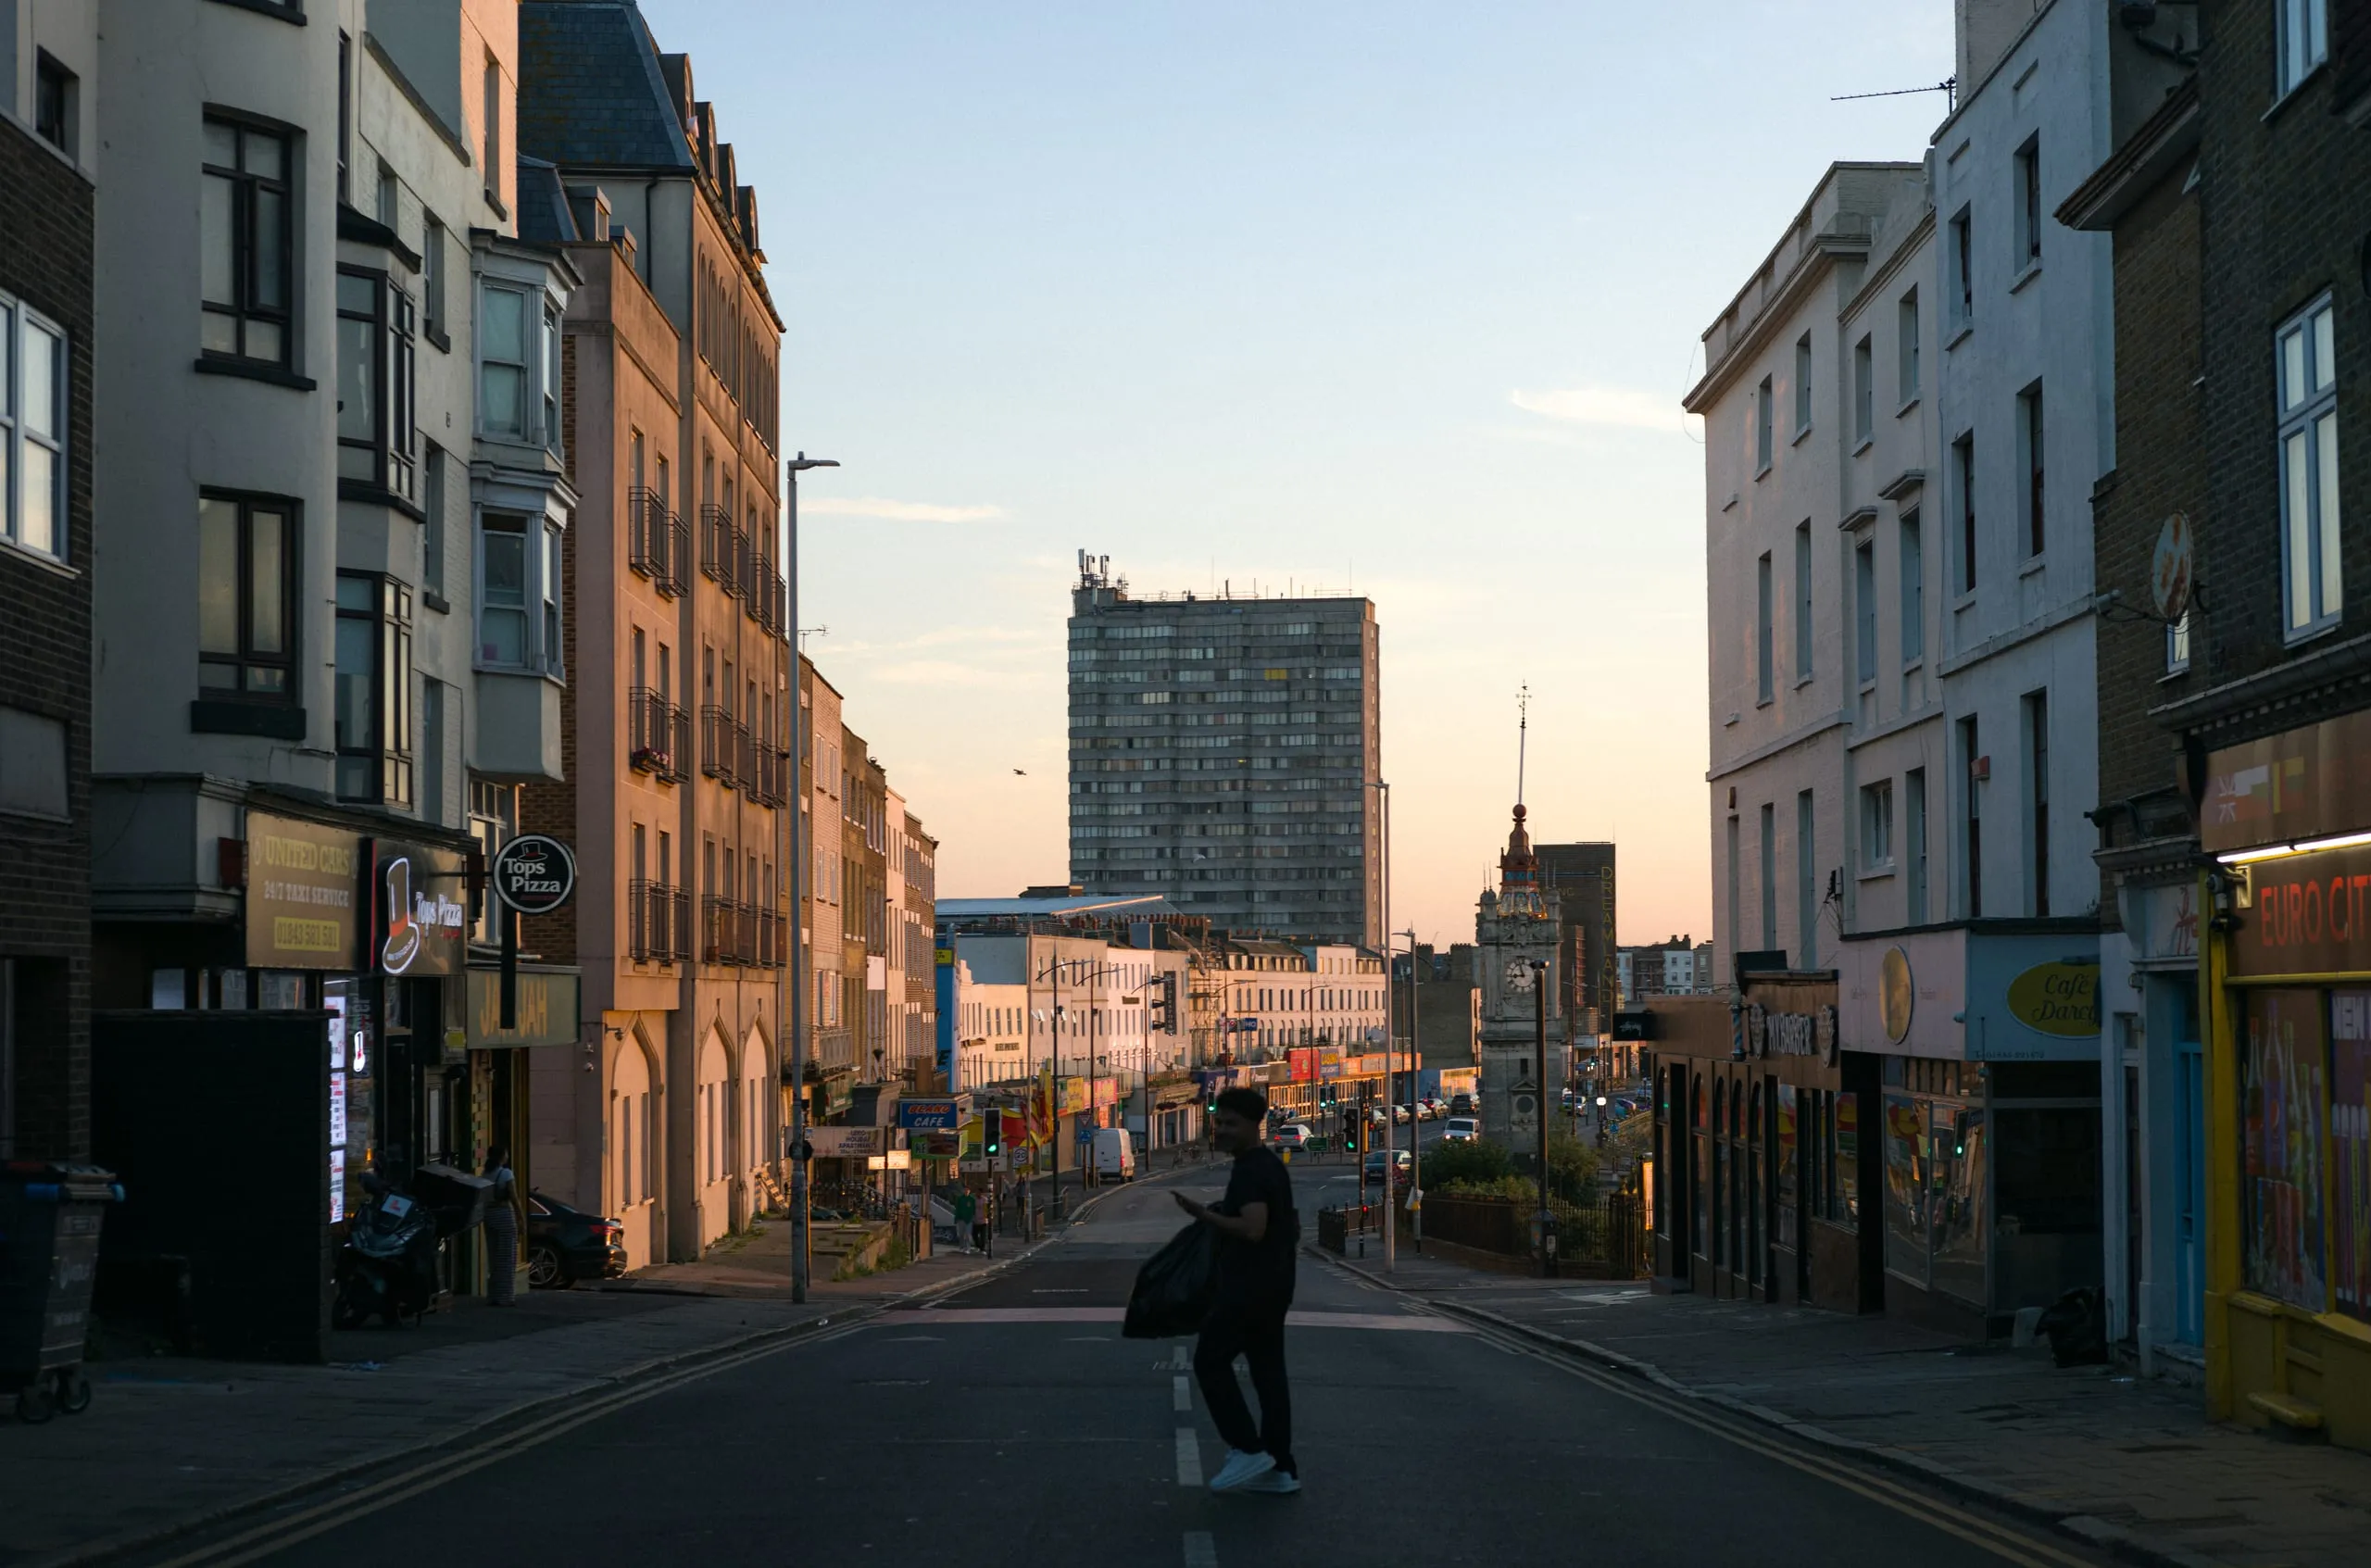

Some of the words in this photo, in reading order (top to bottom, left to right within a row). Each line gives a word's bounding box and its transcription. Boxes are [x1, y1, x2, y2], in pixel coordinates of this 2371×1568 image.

[265, 835, 318, 871] UNITED
[503, 858, 546, 880] Tops
[287, 883, 310, 904] TAXI
[312, 886, 349, 909] SERVICE
[511, 876, 561, 893] Pizza
[415, 891, 437, 937] Tops
[438, 894, 463, 927] Pizza
[2260, 879, 2323, 947] EURO
[2328, 873, 2371, 943] CIT
[1601, 866, 1614, 1003] DREAMLAND
[2044, 972, 2091, 1001] Café
[518, 978, 547, 1038] JAH
[914, 1117, 945, 1127] CAFE
